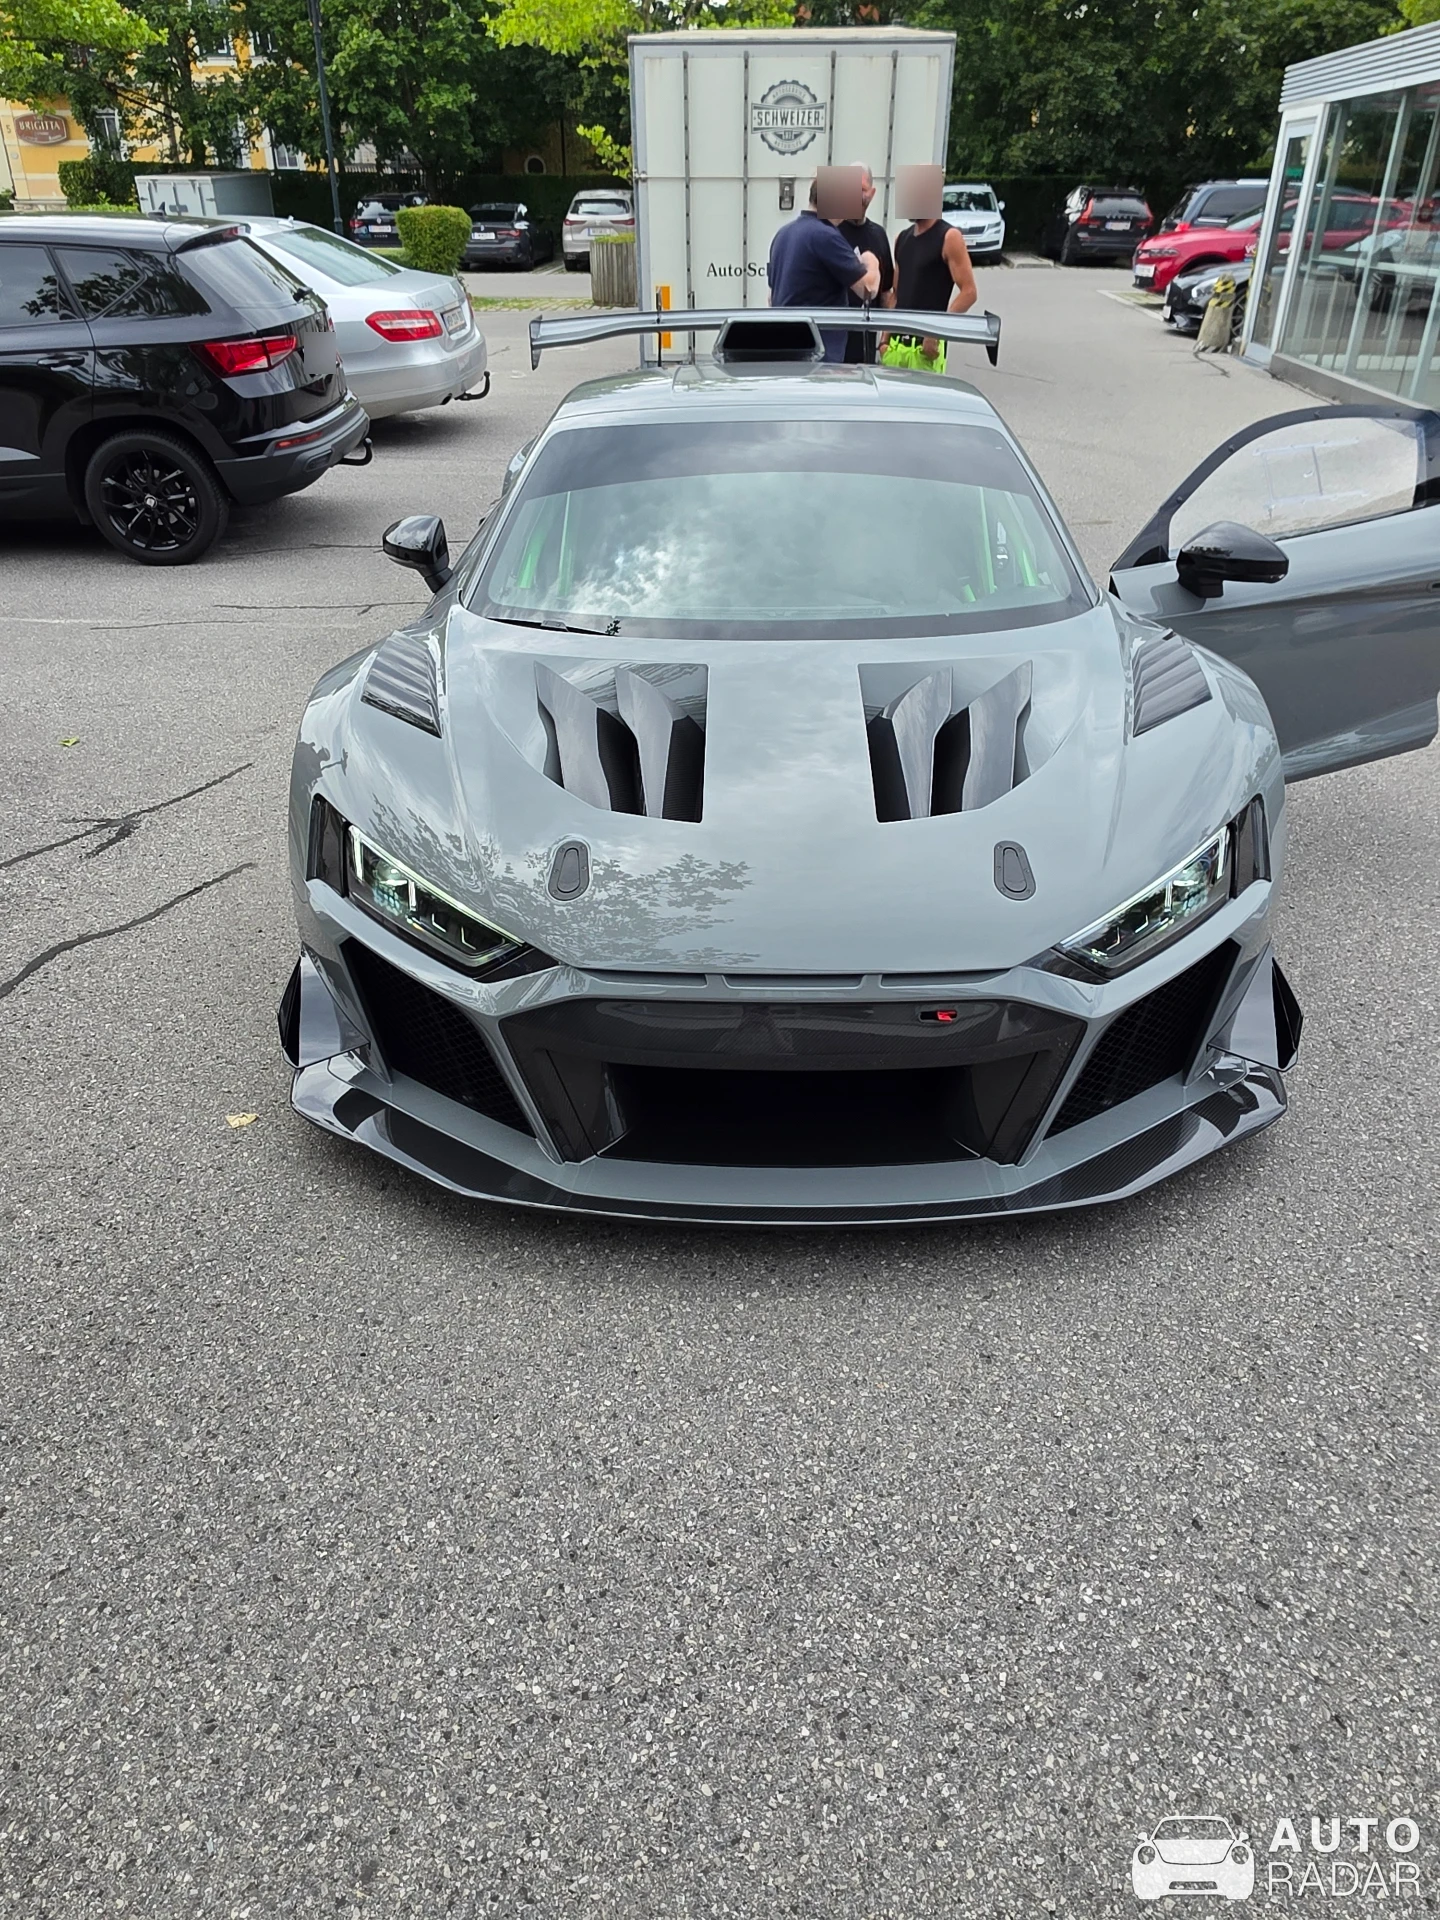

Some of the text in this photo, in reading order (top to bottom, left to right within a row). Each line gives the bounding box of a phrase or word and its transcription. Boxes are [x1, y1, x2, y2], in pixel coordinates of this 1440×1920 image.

[19, 120, 61, 131] BRIGITTA
[757, 110, 820, 126] SCHWEIZER
[706, 262, 743, 278] Auto
